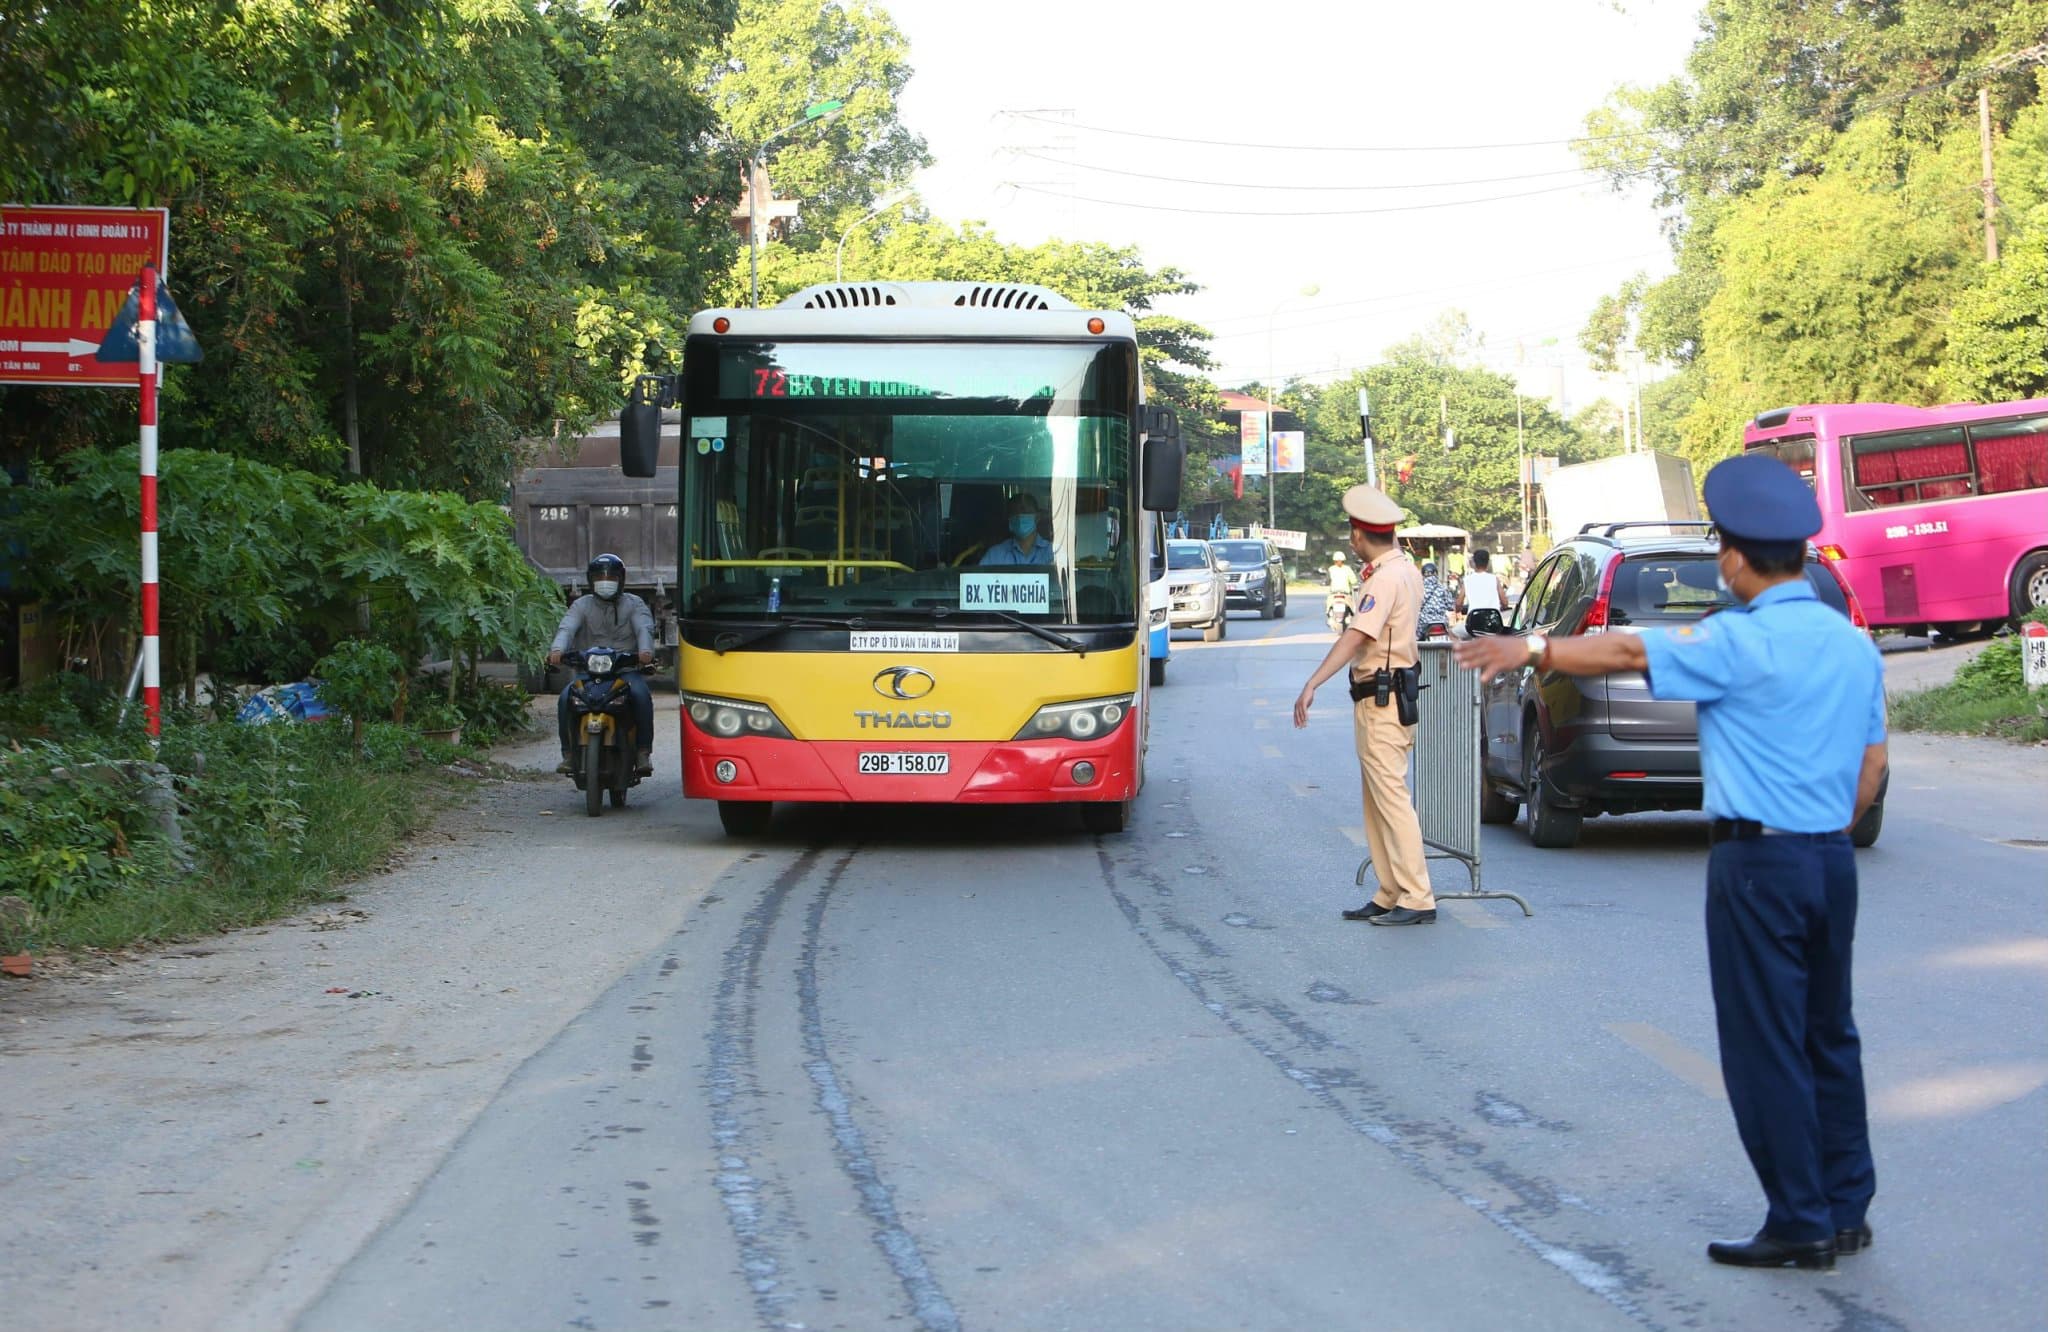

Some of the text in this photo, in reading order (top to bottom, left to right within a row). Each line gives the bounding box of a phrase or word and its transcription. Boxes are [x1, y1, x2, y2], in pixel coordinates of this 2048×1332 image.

[54, 223, 68, 236] AN
[76, 252, 105, 278] TẠO
[0, 280, 70, 328] ÀNH
[23, 362, 40, 370] MAI
[754, 368, 785, 396] 72
[540, 507, 568, 521] 29C
[966, 580, 1047, 604] BX. YÊN NGHĨA
[870, 636, 880, 648] CP
[853, 710, 952, 729] THACO
[861, 755, 946, 772] 29B-158.07
